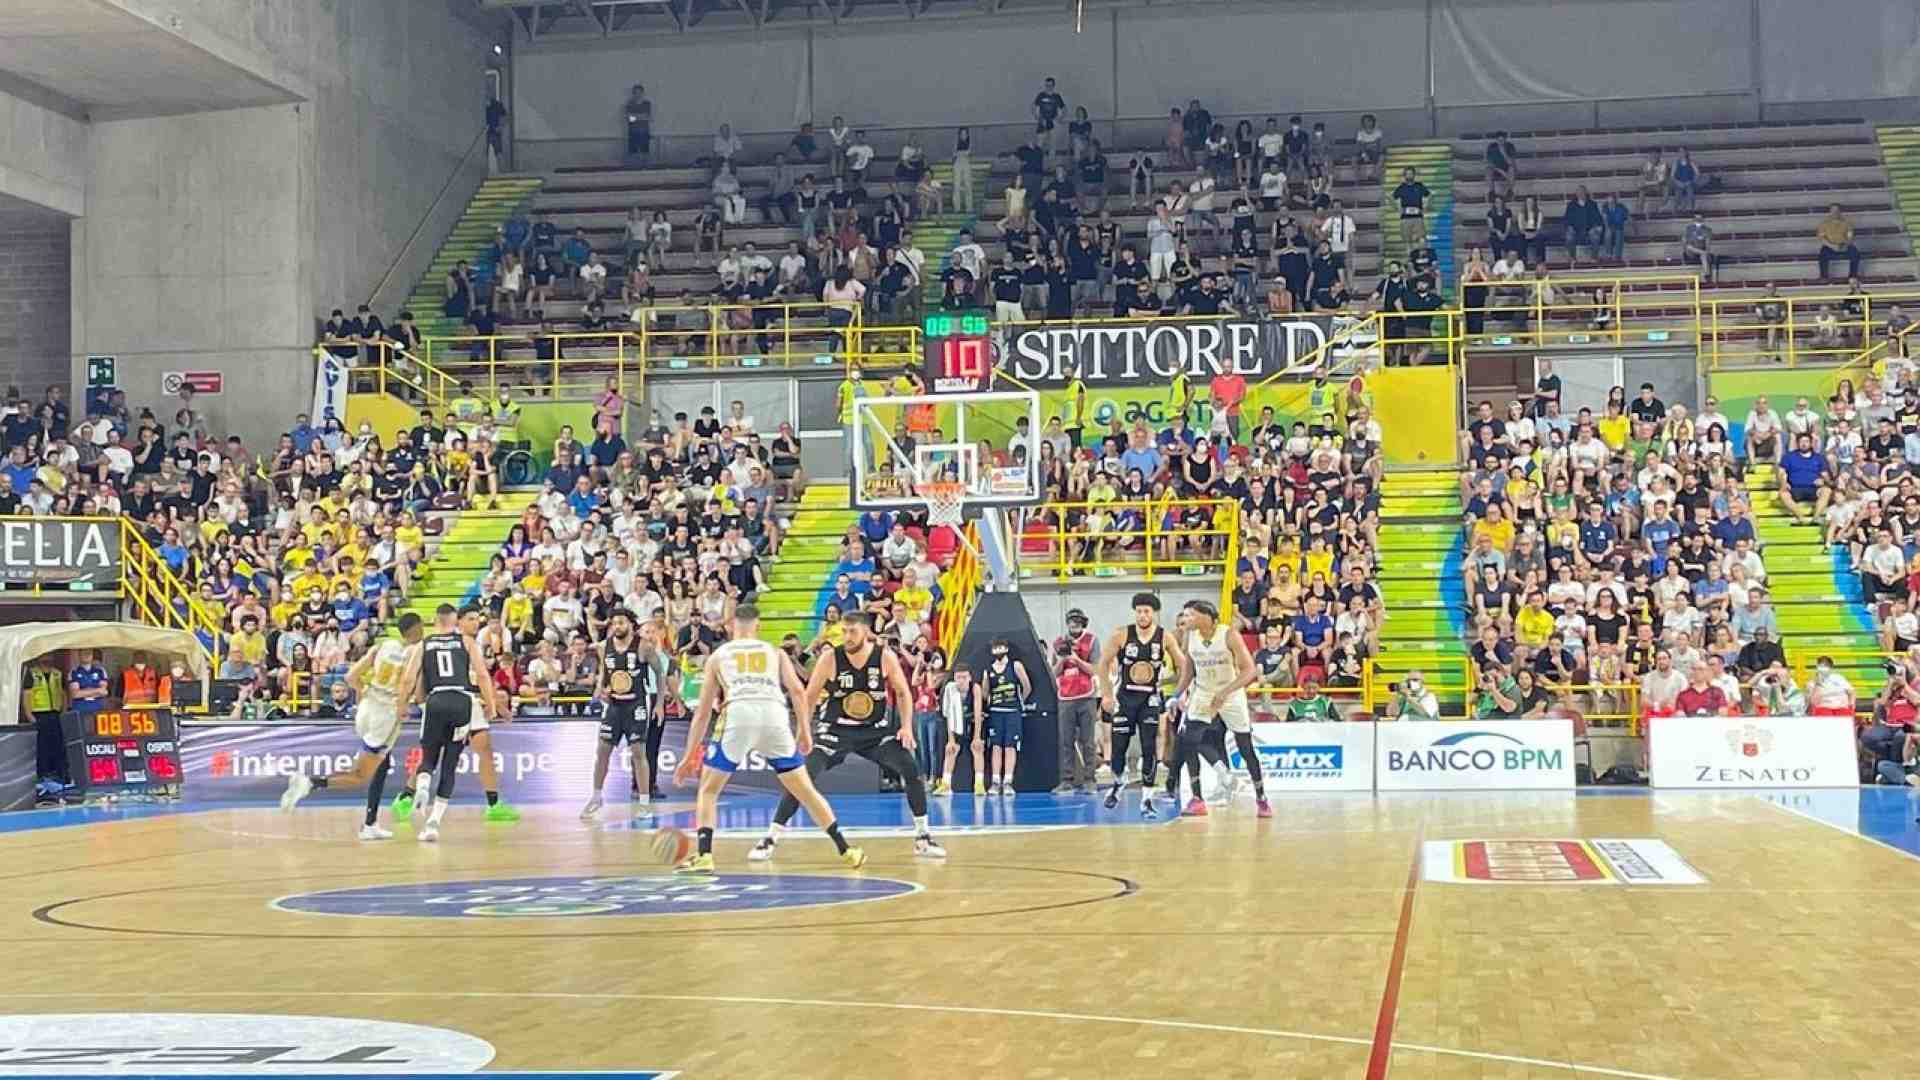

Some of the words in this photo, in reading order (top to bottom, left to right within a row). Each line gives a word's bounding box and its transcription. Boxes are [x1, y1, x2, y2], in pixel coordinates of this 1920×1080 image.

[943, 340, 981, 376] 10
[1015, 323, 1263, 381] SETTORE
[1280, 321, 1326, 373] D
[0, 521, 111, 567] ELIA
[436, 650, 454, 677] 0
[96, 713, 121, 735] 08
[130, 712, 155, 735] 56
[210, 749, 358, 777] #interne
[1254, 749, 1337, 768] entax
[1388, 749, 1496, 771] BANCO
[1503, 749, 1563, 770] BPM
[1695, 766, 1812, 782] ZENATO
[0, 1046, 410, 1065] TEZ
